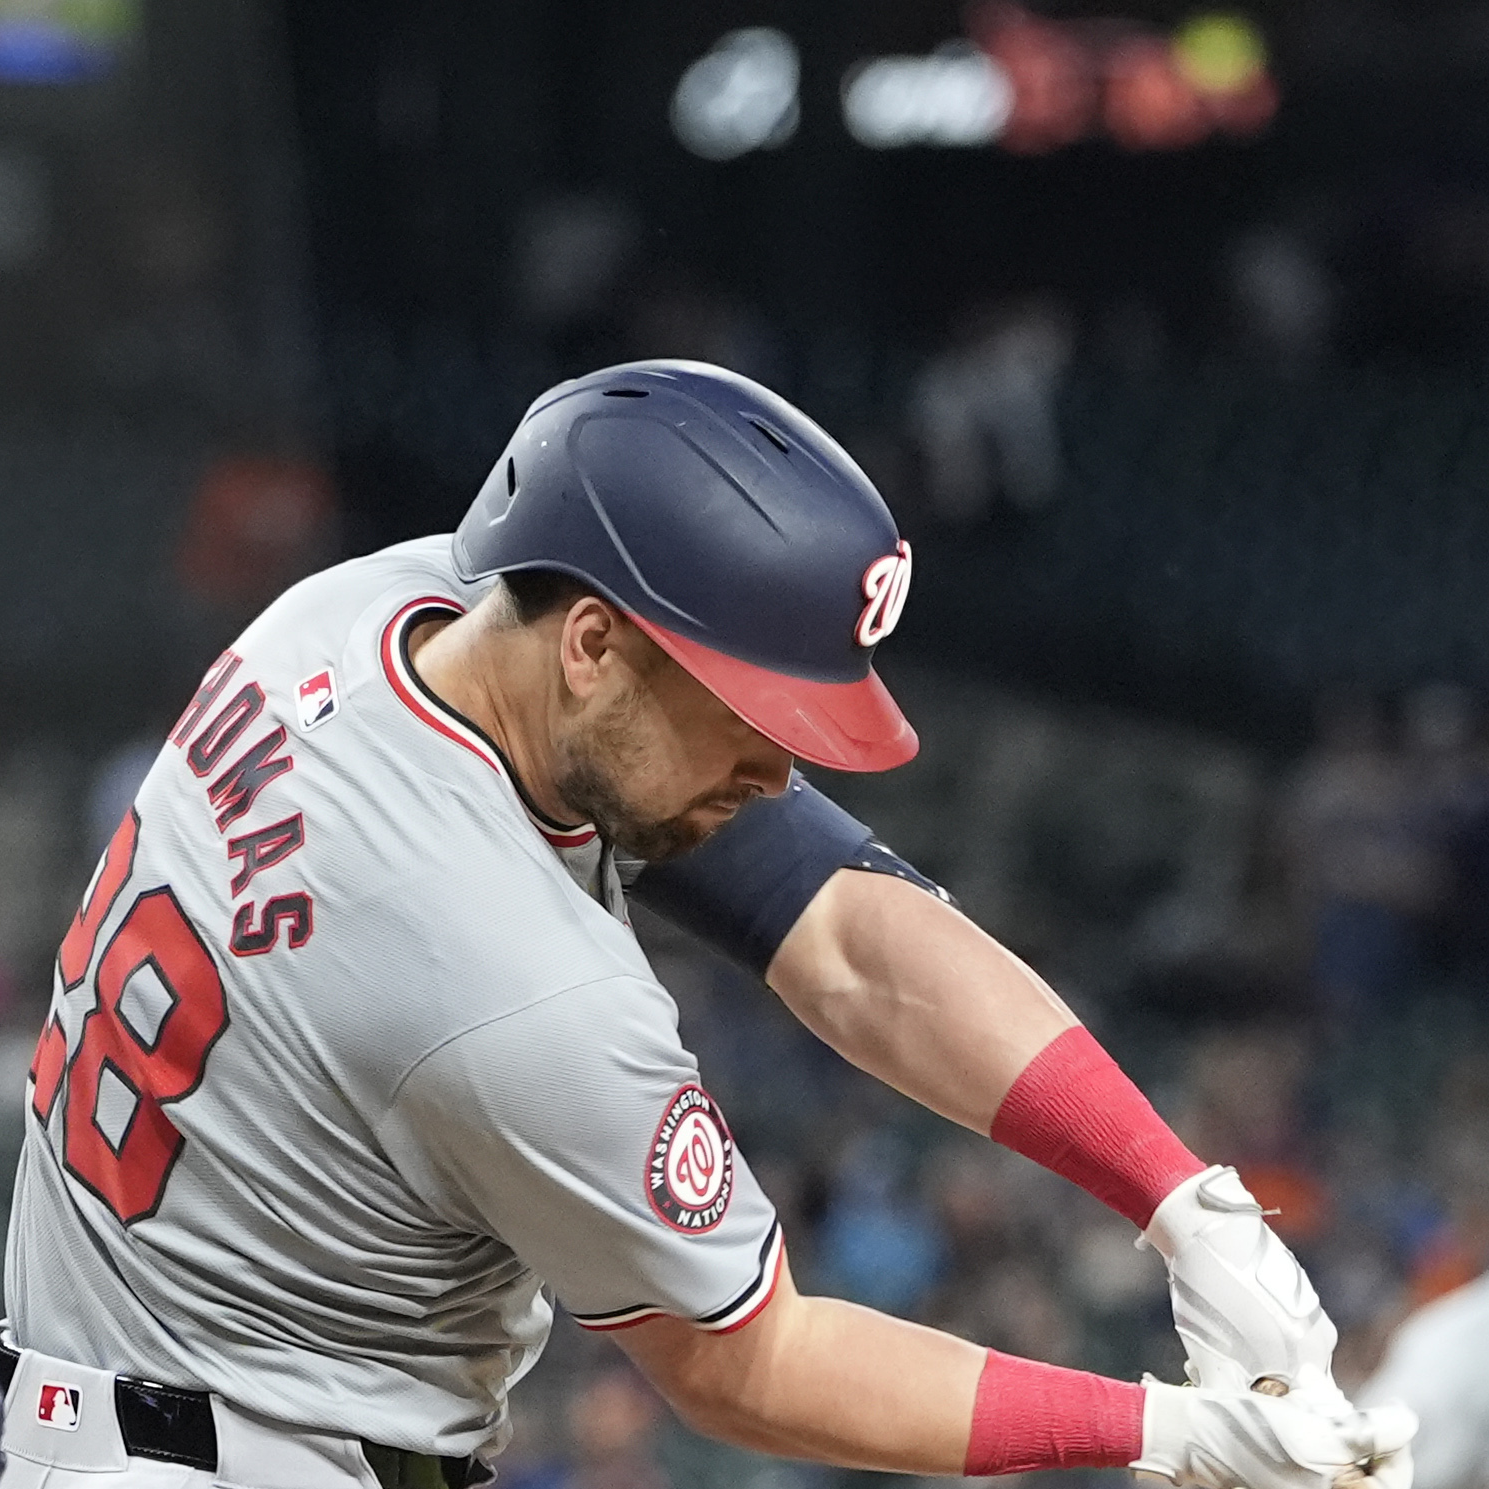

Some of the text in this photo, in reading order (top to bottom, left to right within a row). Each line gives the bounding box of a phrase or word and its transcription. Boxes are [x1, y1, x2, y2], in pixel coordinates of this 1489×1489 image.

[167, 649, 314, 957] HOMAS
[649, 1089, 710, 1190] WASHINGTON
[676, 1139, 733, 1229] NATIONALS
